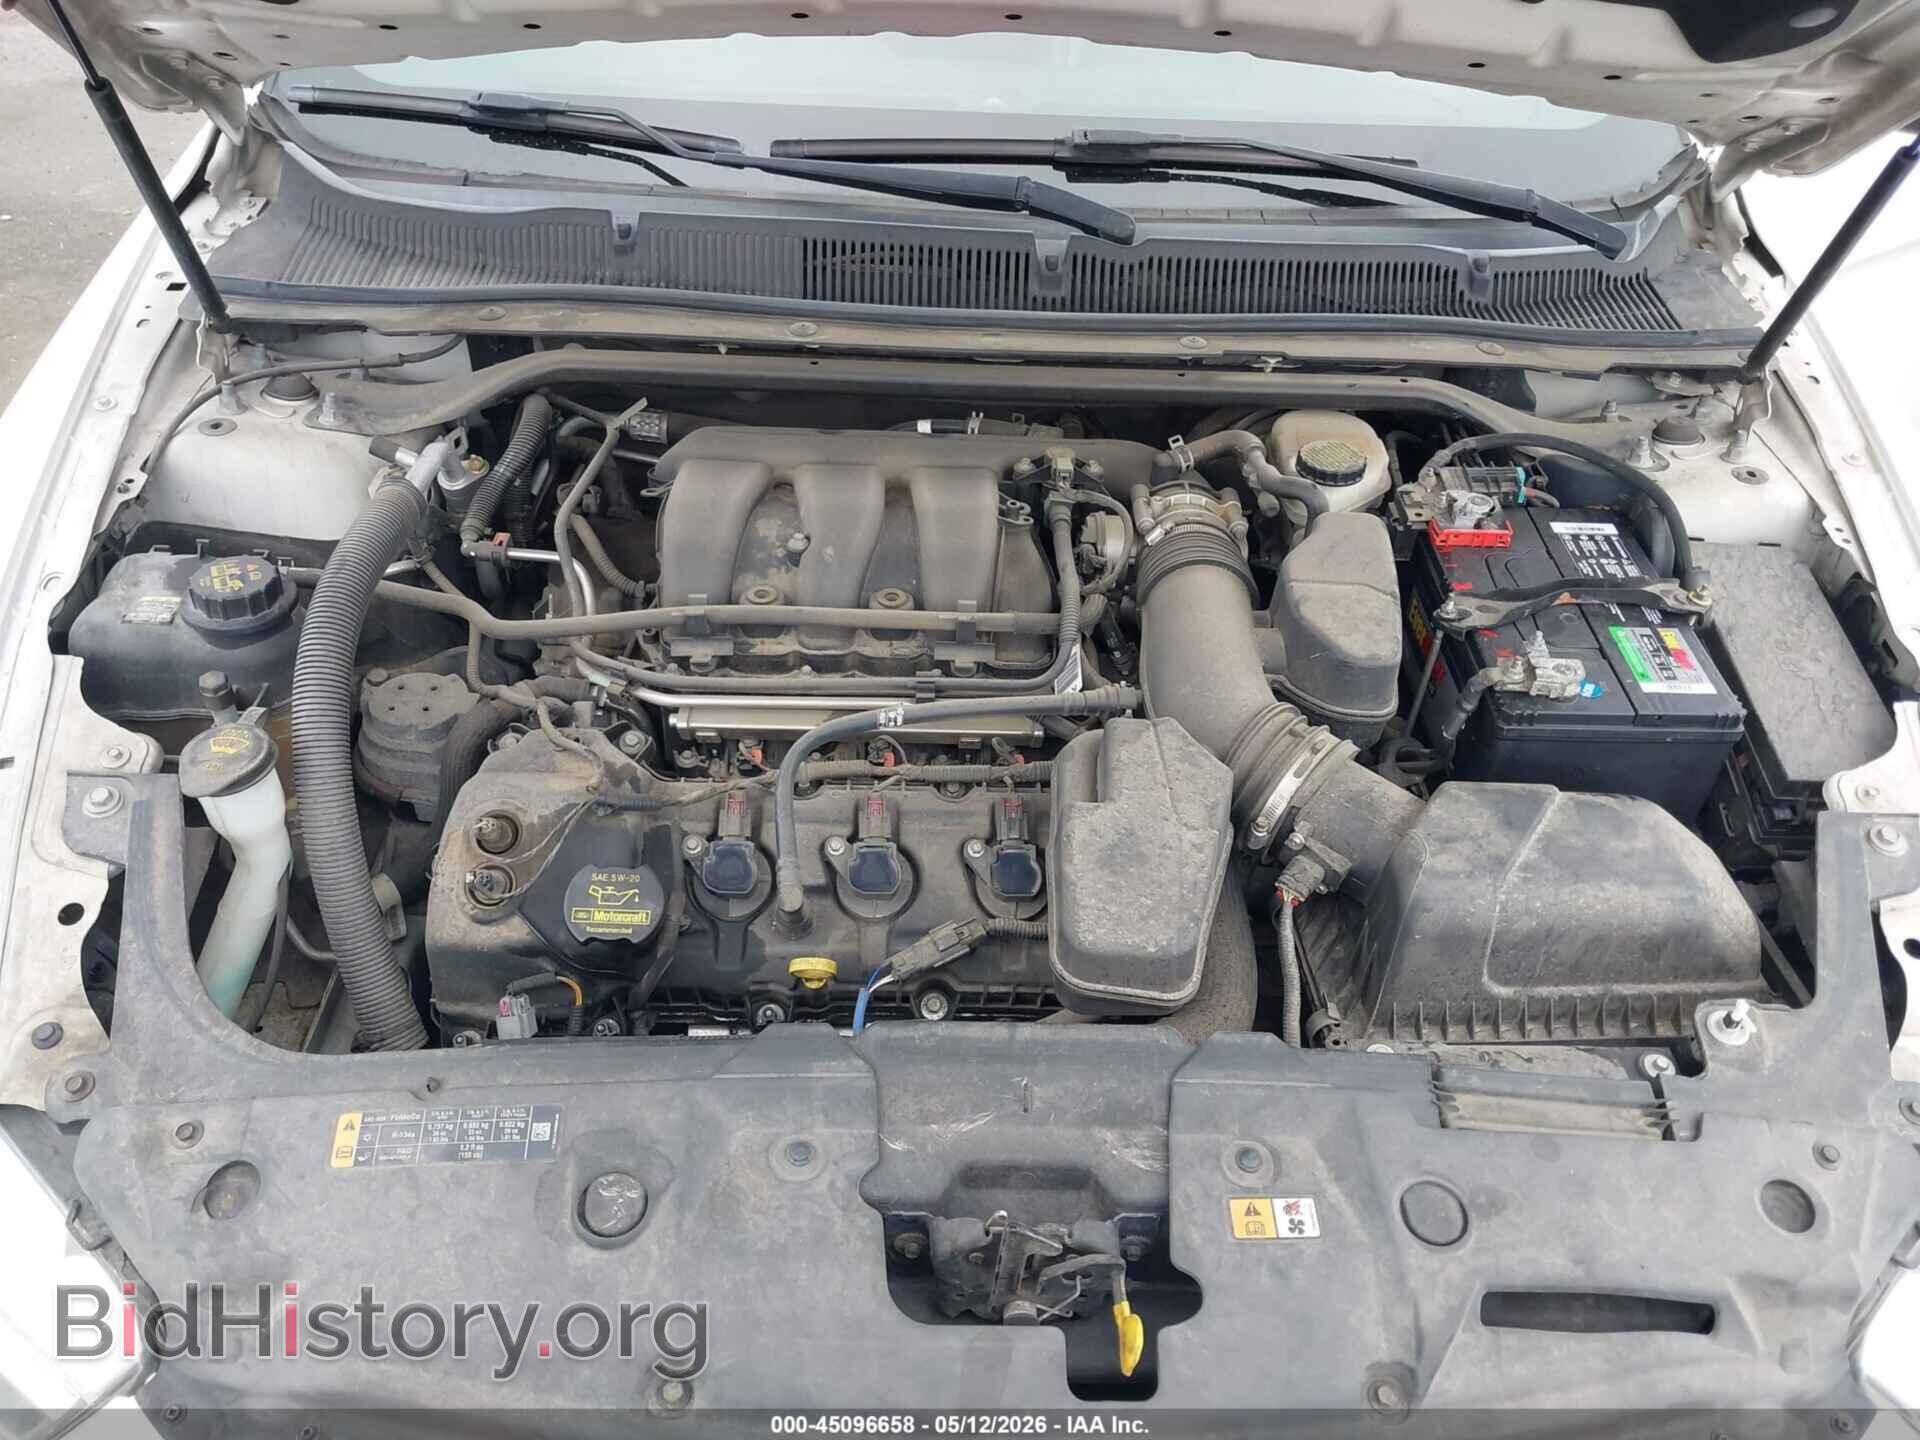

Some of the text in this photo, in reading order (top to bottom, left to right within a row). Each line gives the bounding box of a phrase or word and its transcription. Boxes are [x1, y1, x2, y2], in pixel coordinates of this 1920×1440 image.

[592, 873, 641, 883] SAE 5W-20
[593, 911, 647, 922] Motorcraft
